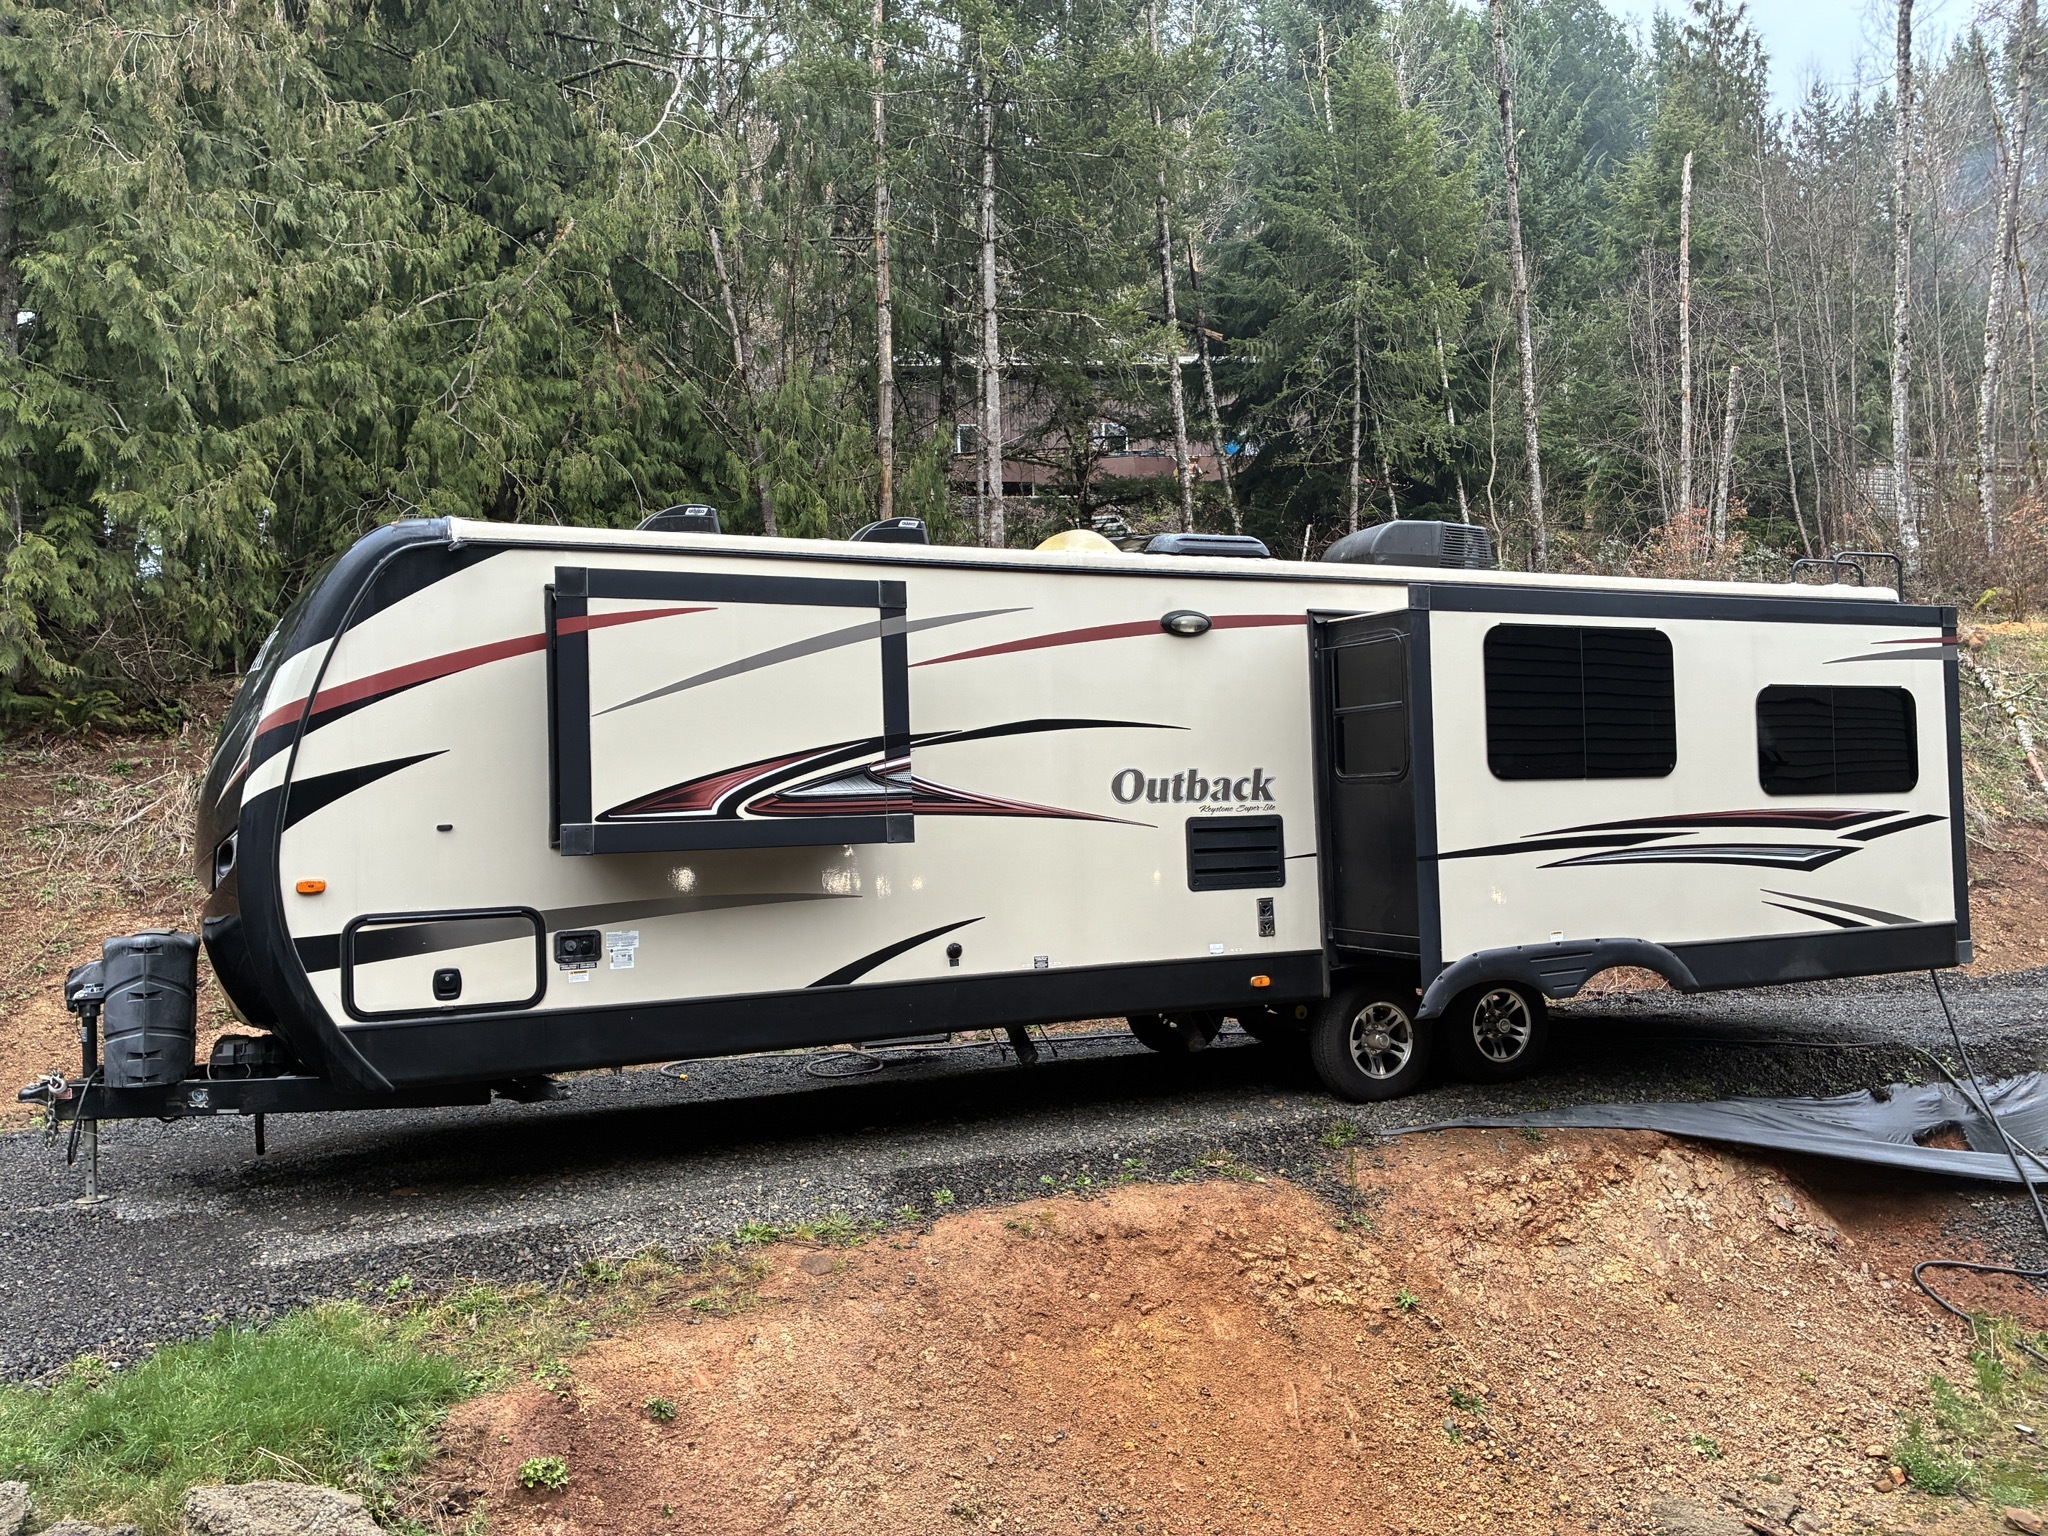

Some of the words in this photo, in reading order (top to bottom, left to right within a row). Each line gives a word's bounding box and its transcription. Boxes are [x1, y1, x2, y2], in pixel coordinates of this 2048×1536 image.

[1111, 768, 1276, 804] Outback
[1199, 805, 1233, 815] Keystone
[1236, 804, 1276, 814] Super-Lite
